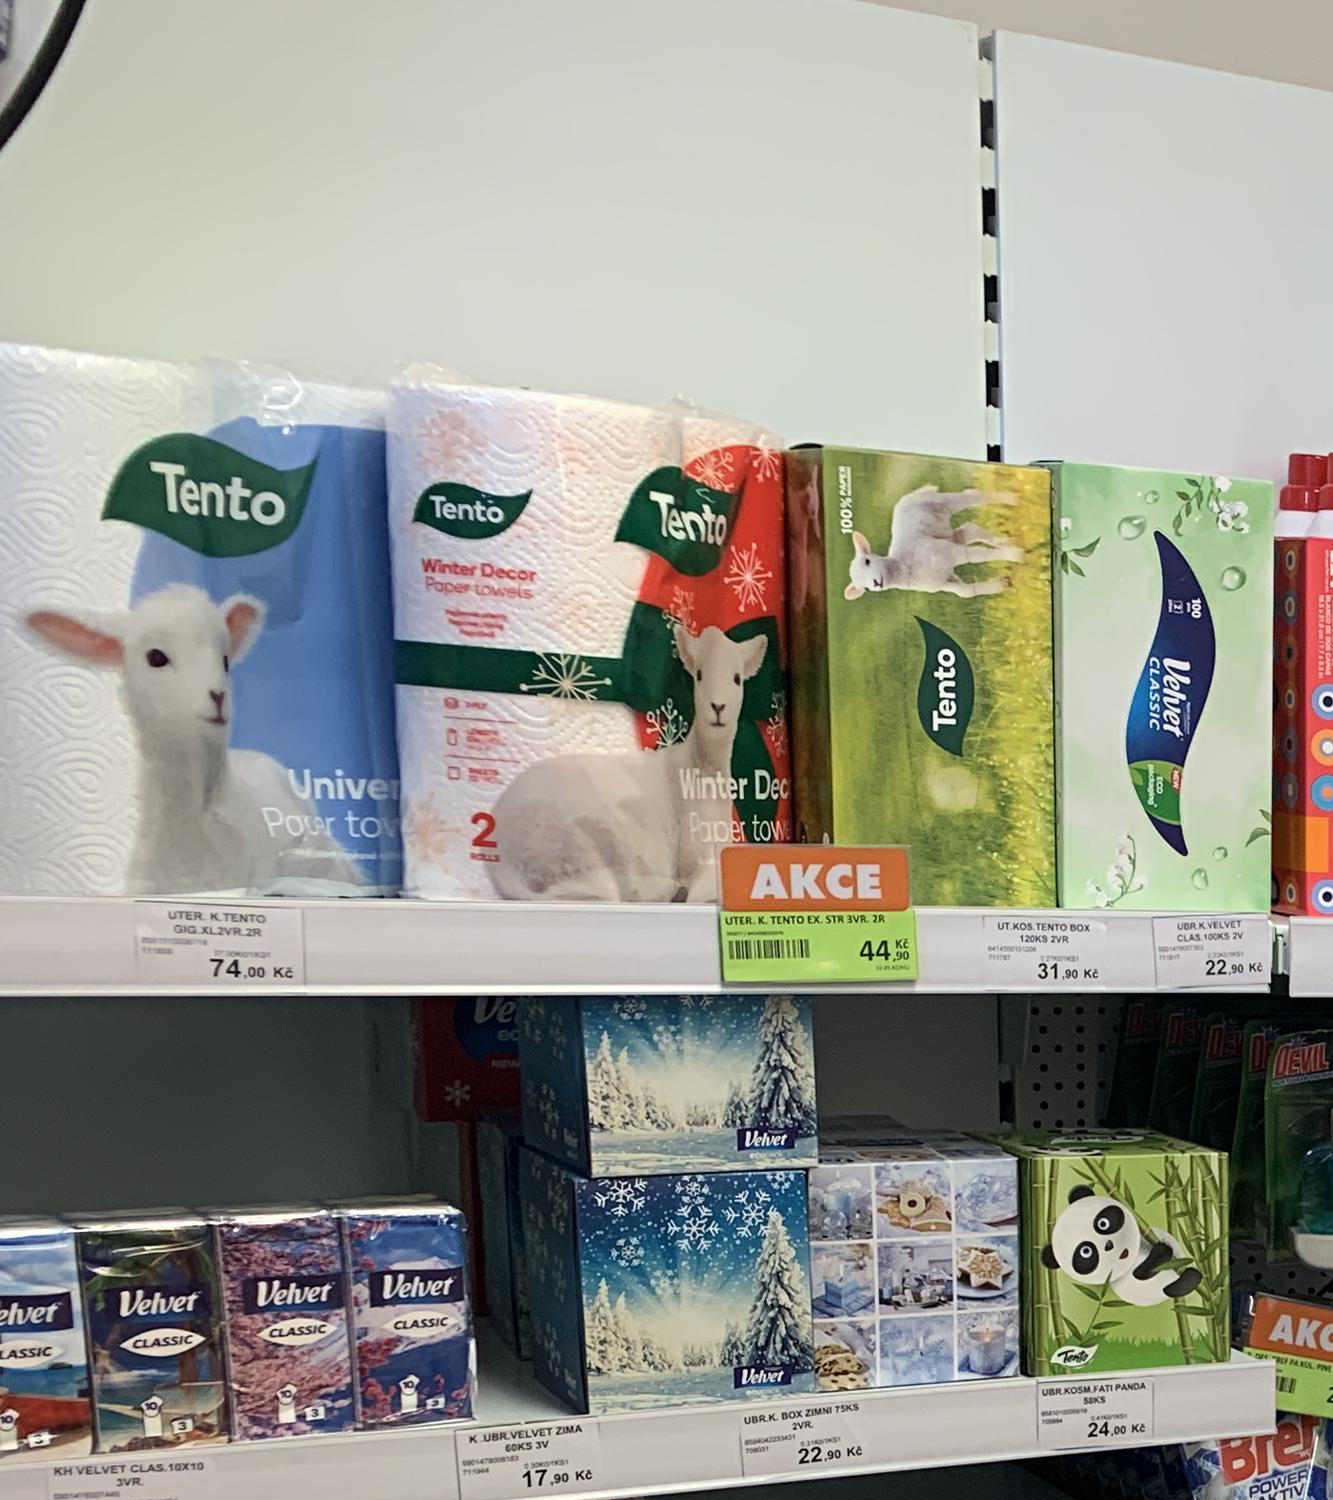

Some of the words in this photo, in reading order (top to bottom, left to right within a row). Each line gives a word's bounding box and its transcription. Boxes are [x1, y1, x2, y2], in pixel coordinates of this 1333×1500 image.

[150, 461, 286, 526] Tento
[428, 495, 505, 524] Tento
[649, 491, 728, 545] Tento
[421, 558, 476, 578] Winter
[480, 565, 536, 584] Decor
[933, 648, 956, 732] Tento
[1148, 657, 1161, 731] CLASSIC
[1162, 657, 1191, 740] Velvet
[751, 864, 882, 899] AKCE
[168, 910, 204, 922] UTER.
[724, 915, 752, 926] UTER.
[757, 916, 767, 925] K.
[770, 915, 803, 925] TENTO
[824, 915, 843, 924] STR
[872, 915, 885, 924] 2R
[273, 964, 294, 979] Kč
[1083, 968, 1098, 979] Kč
[382, 1273, 456, 1298] Velvet
[119, 1291, 199, 1317] Velvet
[394, 1316, 449, 1331] CLASSIC
[132, 1332, 194, 1351] CLASSIC
[741, 1369, 784, 1387] Velvet
[1113, 1382, 1146, 1393] PANDA
[1132, 1423, 1146, 1434] Kč
